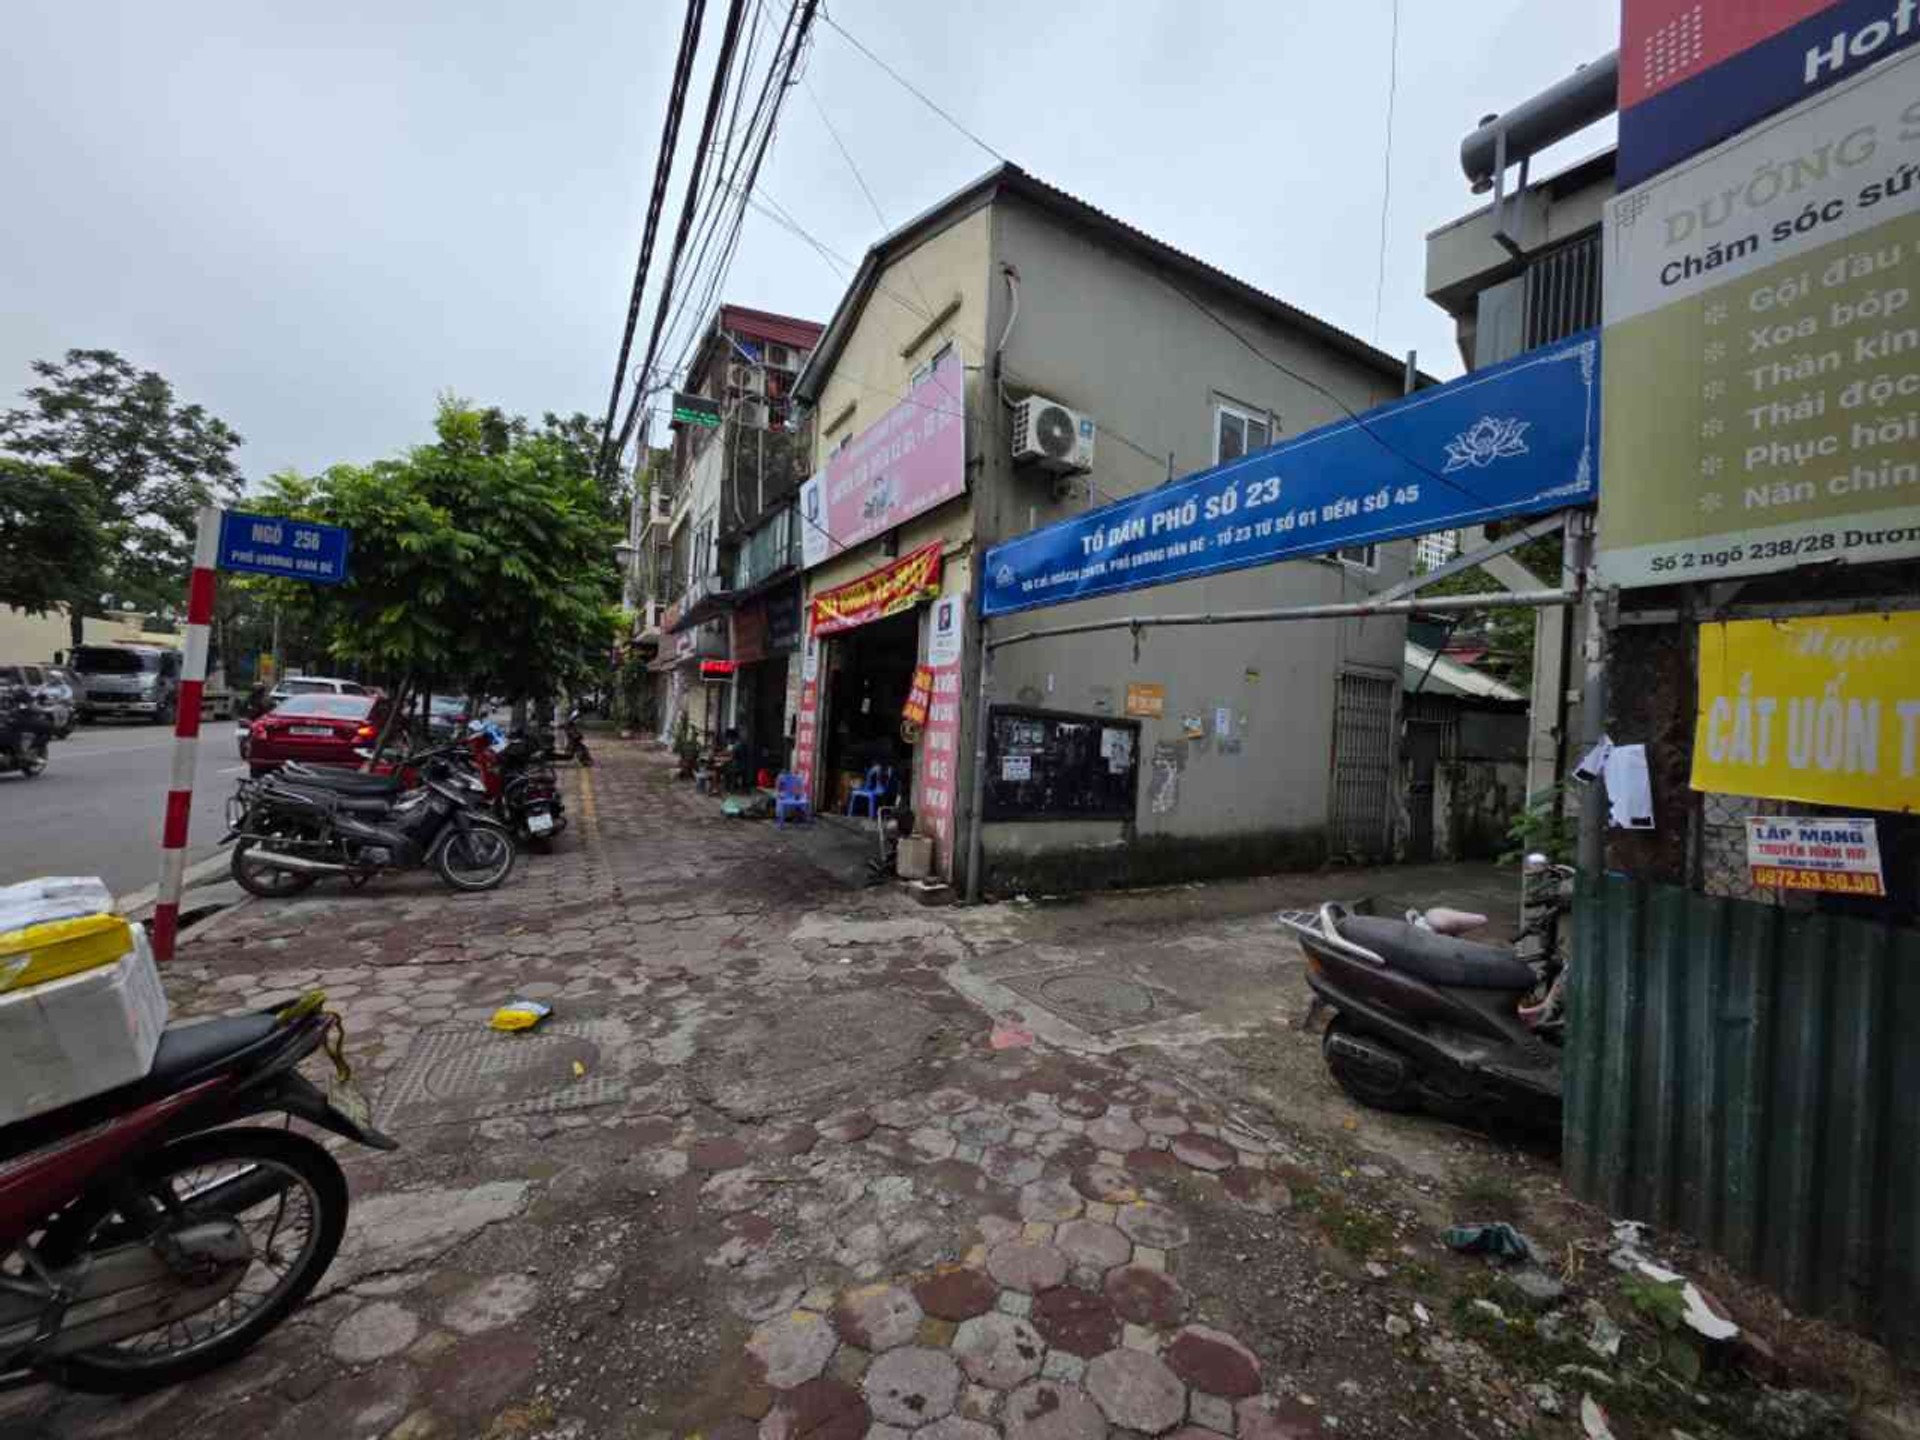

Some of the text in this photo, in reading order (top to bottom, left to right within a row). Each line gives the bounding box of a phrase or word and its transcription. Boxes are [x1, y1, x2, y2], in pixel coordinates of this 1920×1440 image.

[1664, 125, 1878, 247] DƯỠNG
[1660, 162, 1920, 286] Chăm sóc sứ
[1750, 244, 1901, 312] Gội đầu
[1749, 287, 1910, 353] Xoa bóp
[1839, 373, 1920, 409] độc
[1744, 434, 1838, 471] Phục
[1151, 494, 1199, 536] PHỐ
[1204, 481, 1240, 520] SỐ
[1245, 476, 1281, 508] 23
[1275, 509, 1296, 533] SỐ
[1362, 485, 1390, 513] SỐ
[1394, 484, 1420, 505] 45
[1651, 556, 1676, 572] Số
[1682, 553, 1694, 569] 2
[1750, 532, 1835, 560] 238/28
